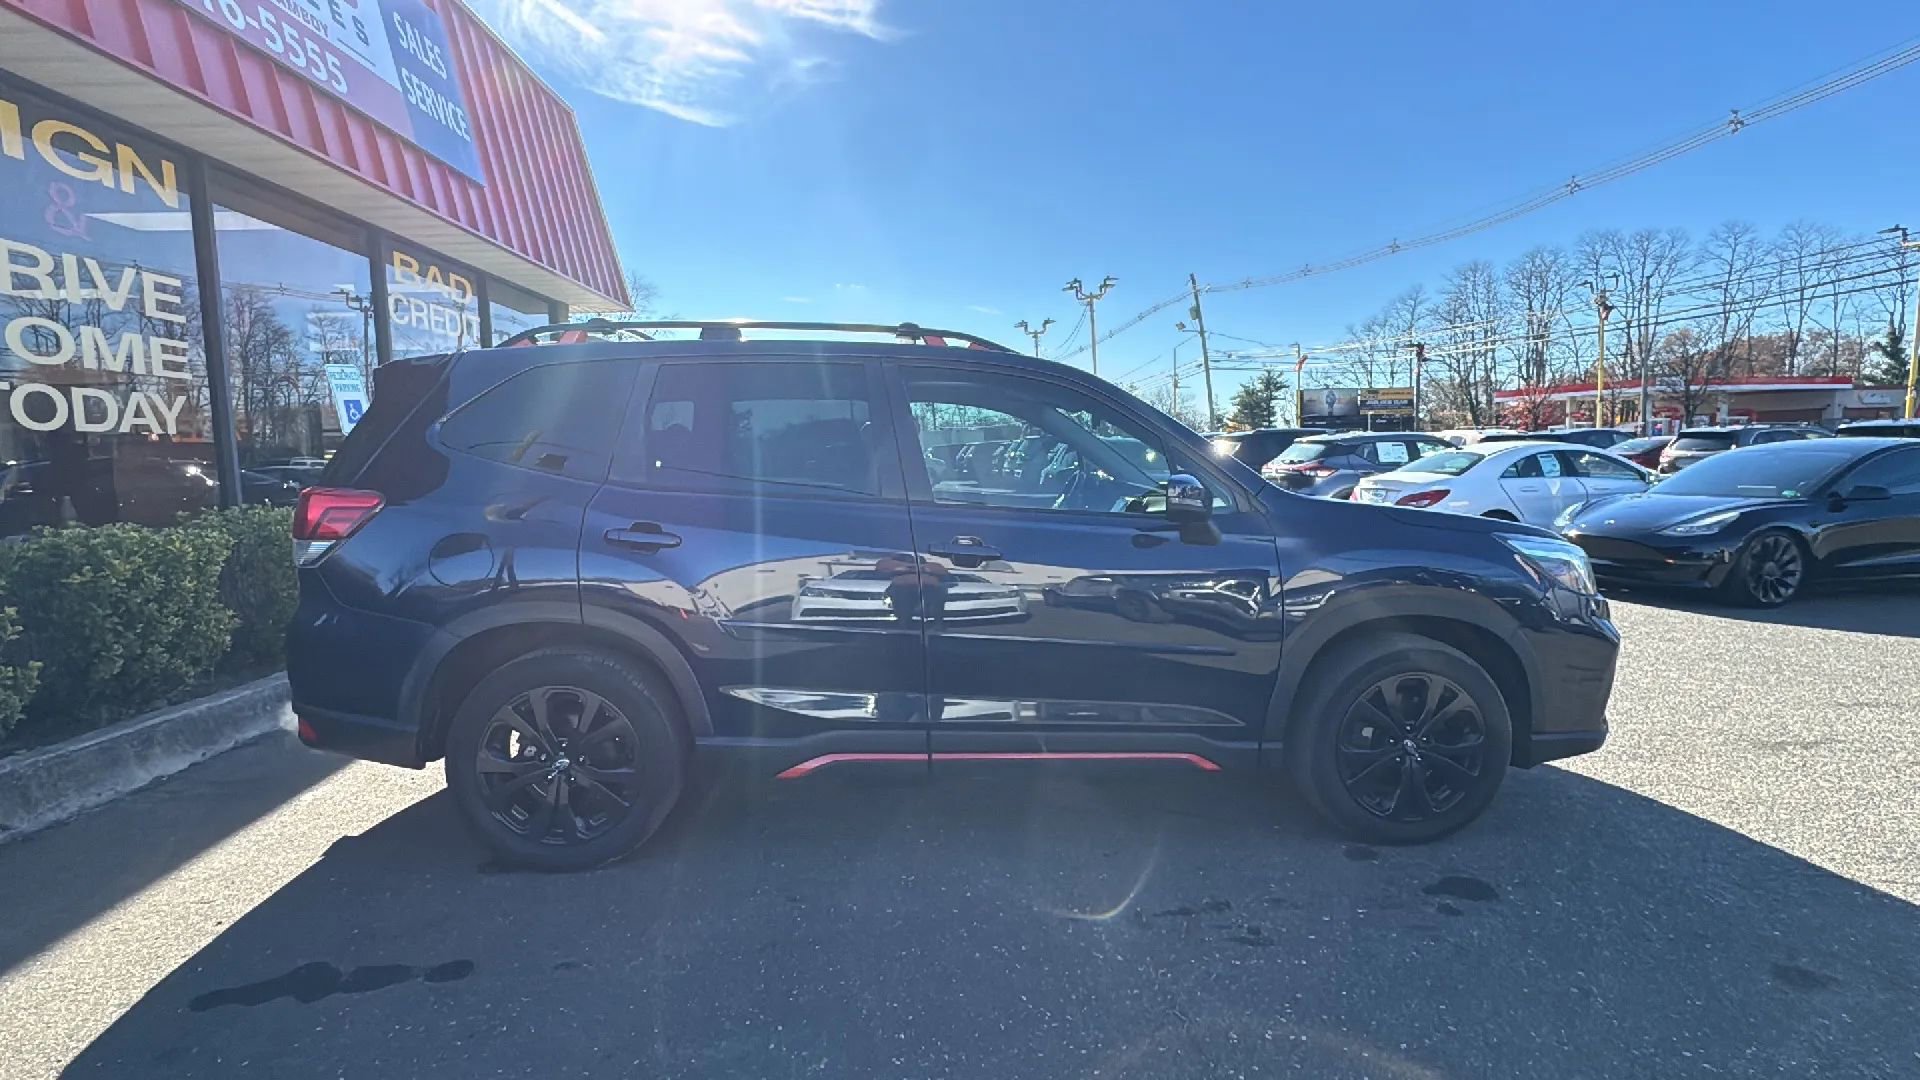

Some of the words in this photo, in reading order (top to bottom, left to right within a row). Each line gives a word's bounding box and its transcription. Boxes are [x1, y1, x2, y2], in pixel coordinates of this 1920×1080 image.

[392, 11, 448, 80] SALES
[401, 67, 471, 142] SERVICE
[0, 100, 179, 209] IGN
[0, 237, 187, 324] RIVE
[393, 251, 473, 306] BAD
[5, 316, 193, 380] OME
[387, 292, 481, 342] CREDIT
[334, 383, 362, 393] PARKING
